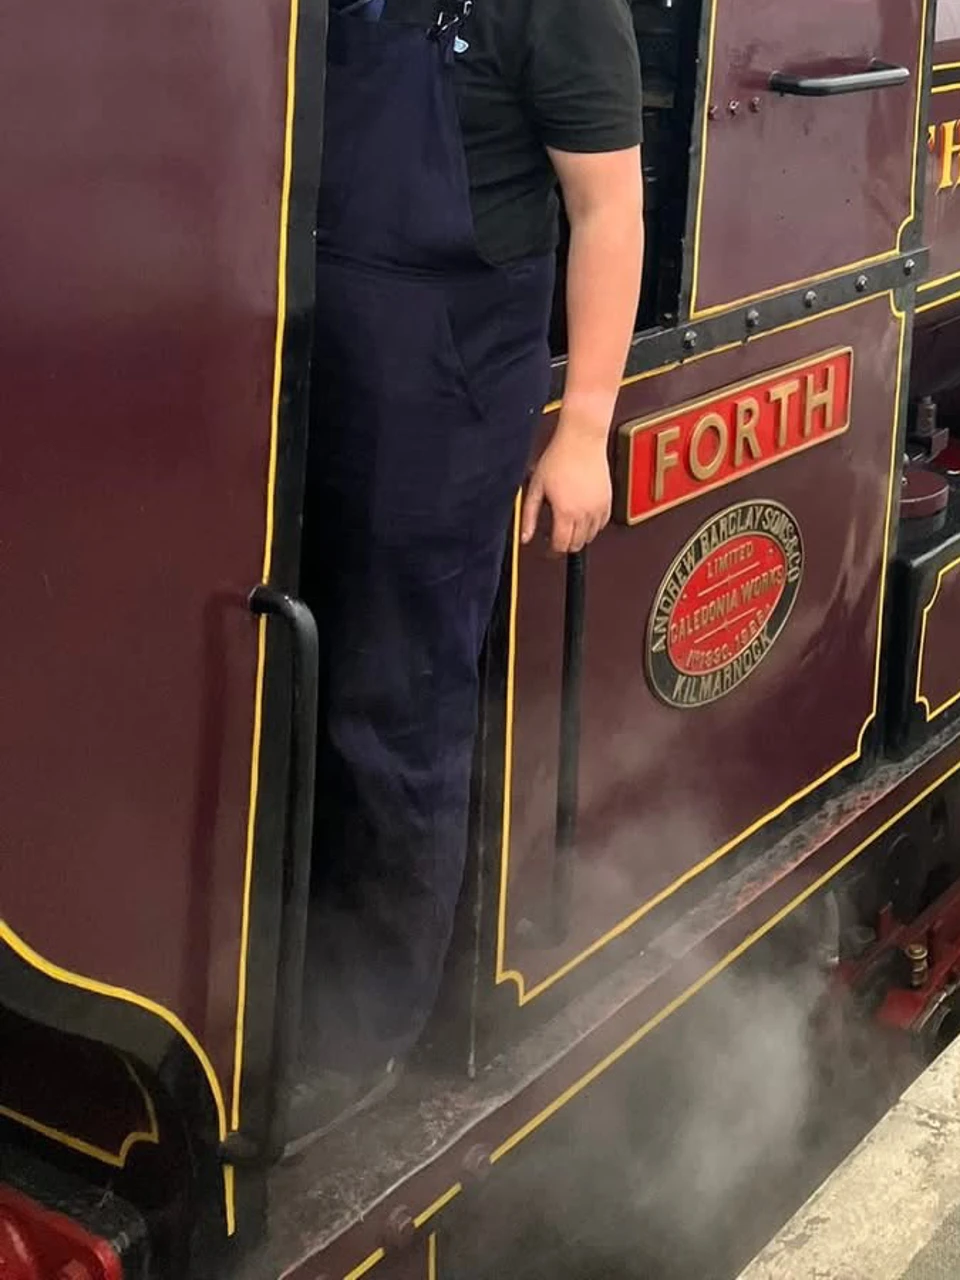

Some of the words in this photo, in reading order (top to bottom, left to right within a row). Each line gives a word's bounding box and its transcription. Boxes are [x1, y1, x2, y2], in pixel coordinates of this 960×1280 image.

[653, 364, 835, 502] FORTH
[652, 544, 696, 653] ANDREW
[700, 506, 764, 556] BARCLAY
[707, 541, 754, 578] LIMITED
[670, 589, 740, 644] CALEDONIA
[672, 624, 773, 703] KILMARNOCK
